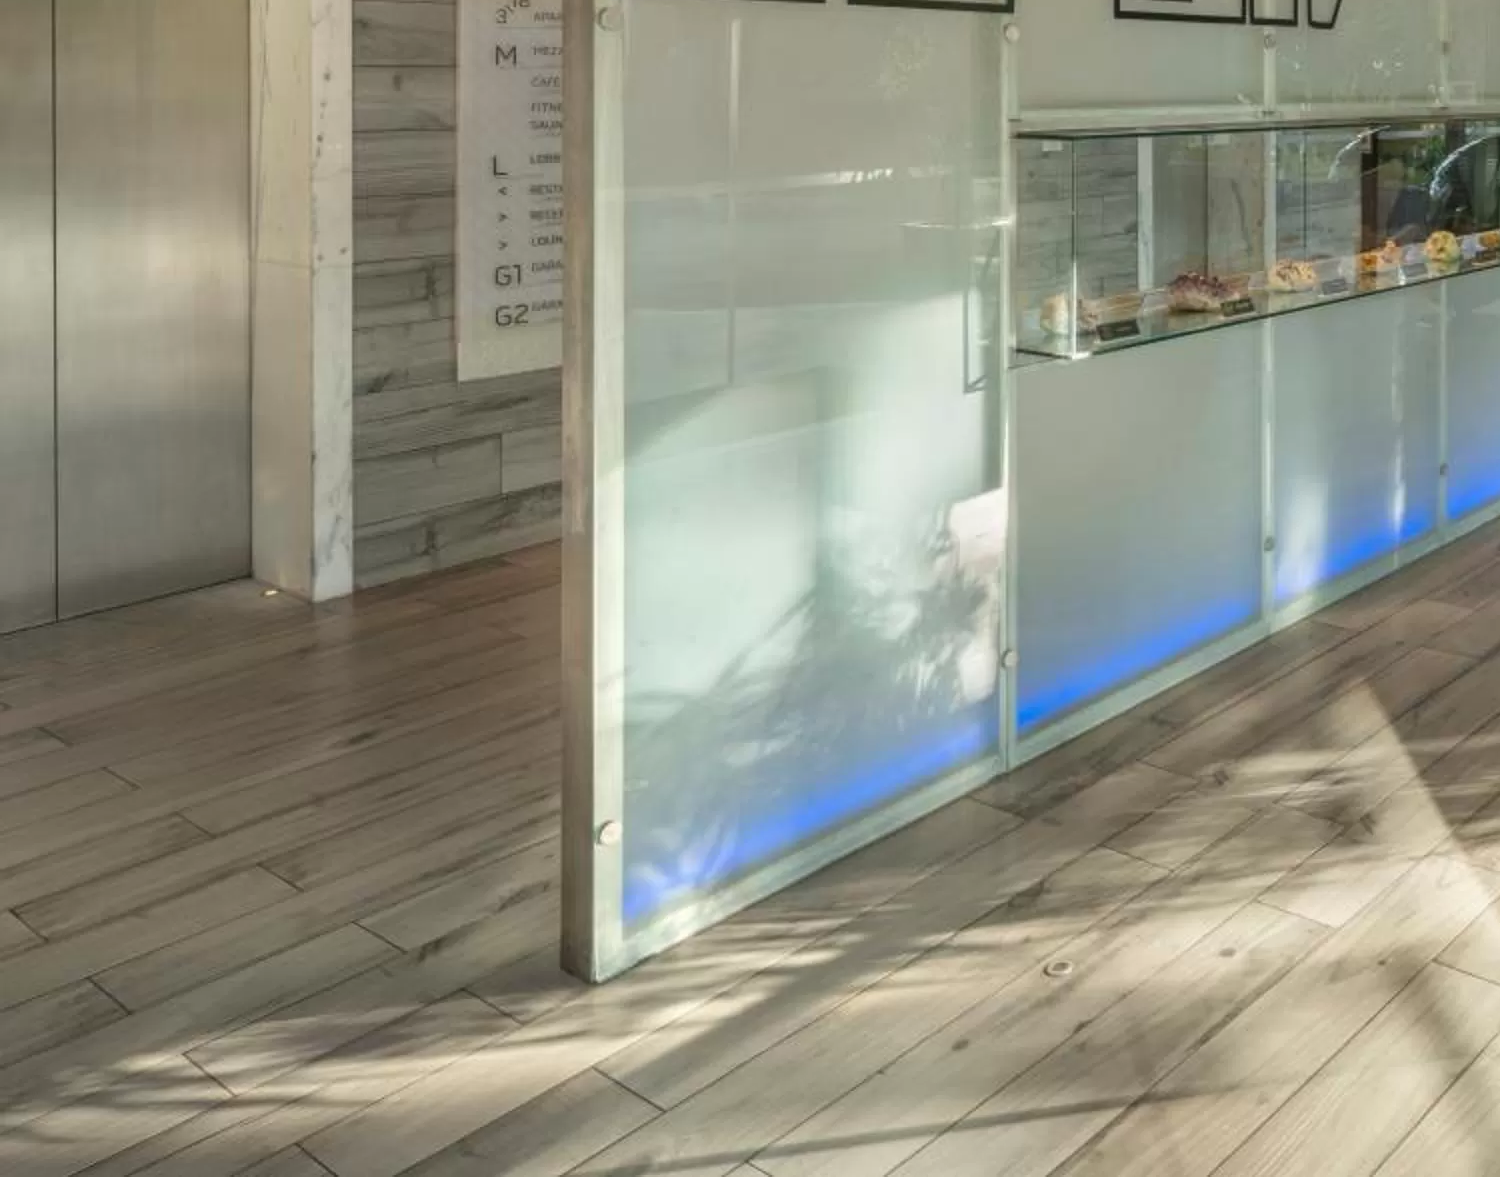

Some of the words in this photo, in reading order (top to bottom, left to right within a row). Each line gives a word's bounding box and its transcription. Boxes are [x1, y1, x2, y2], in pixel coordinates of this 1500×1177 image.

[495, 44, 517, 66] M
[493, 155, 508, 176] L
[495, 264, 521, 286] G1
[495, 304, 529, 326] G2
